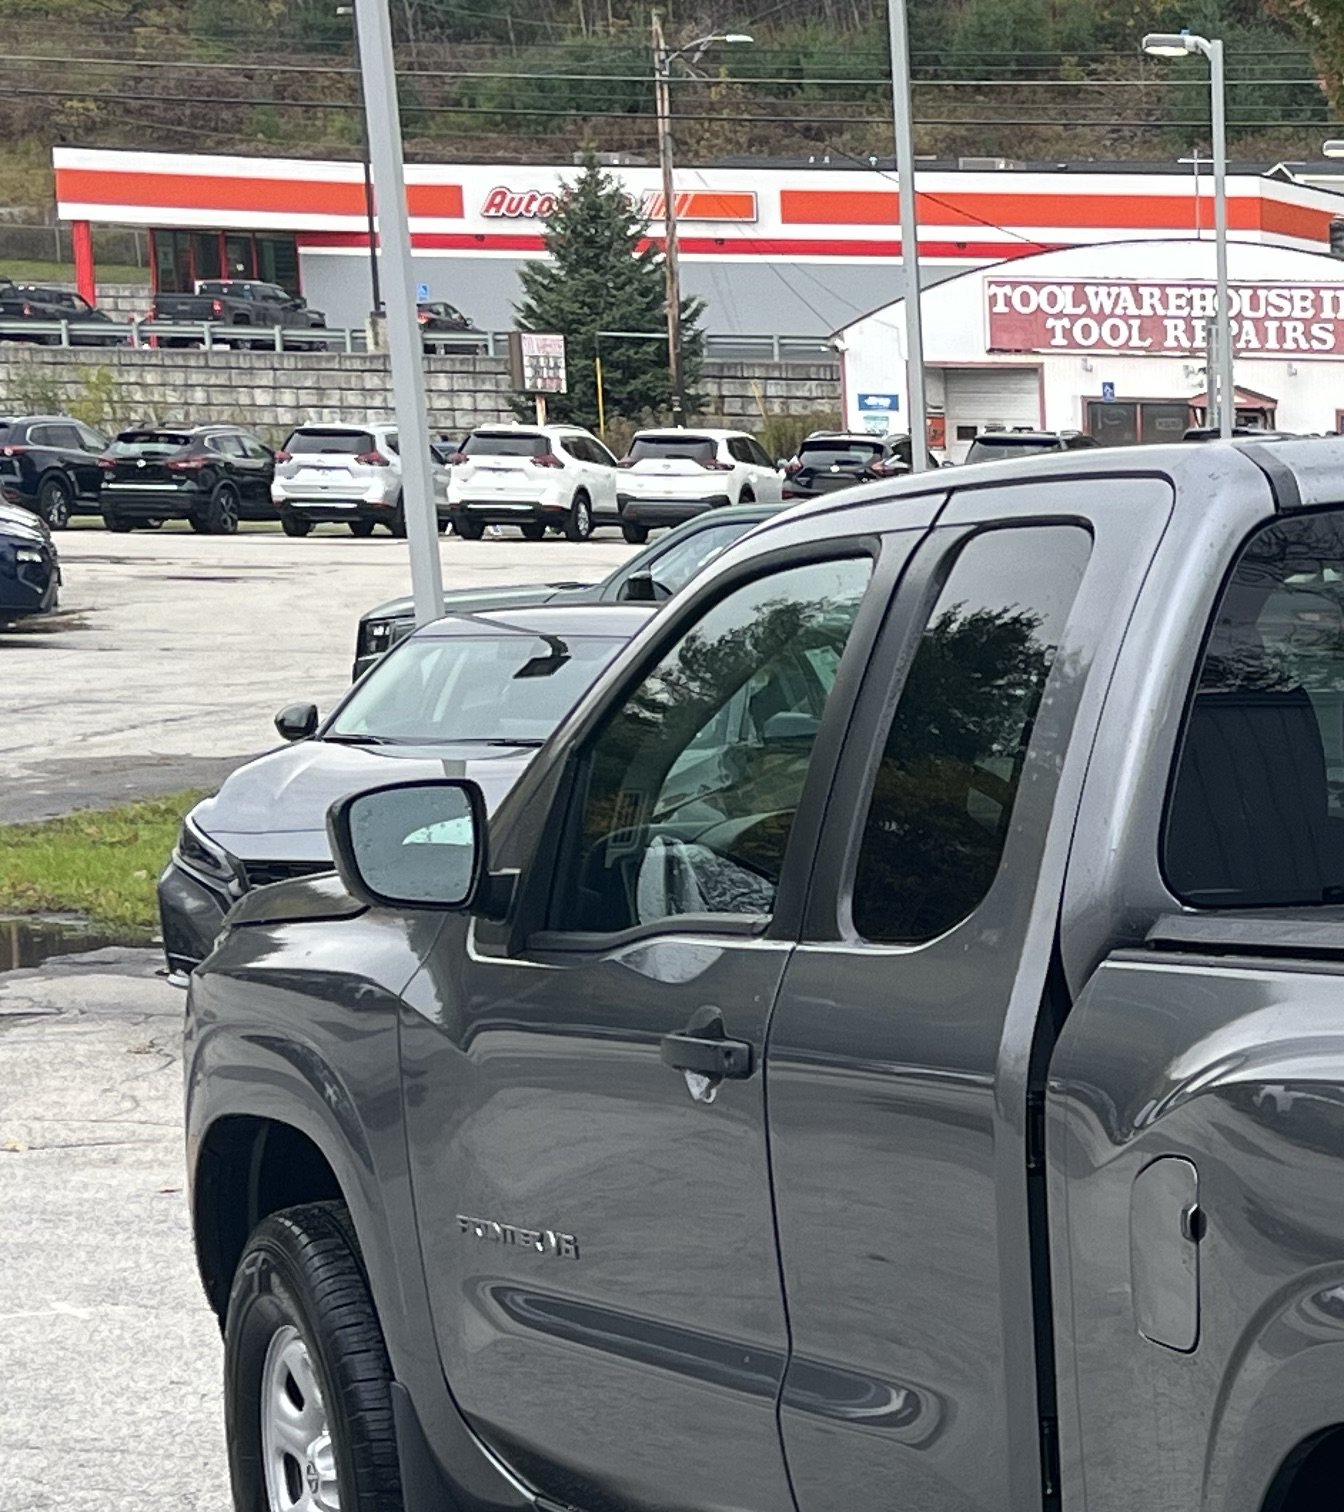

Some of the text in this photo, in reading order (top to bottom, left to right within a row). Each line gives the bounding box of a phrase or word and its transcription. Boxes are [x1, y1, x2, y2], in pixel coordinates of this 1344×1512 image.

[988, 284, 1087, 315] TOOL
[1084, 286, 1316, 319] WAREHOUSE
[1046, 317, 1153, 347] TOOL
